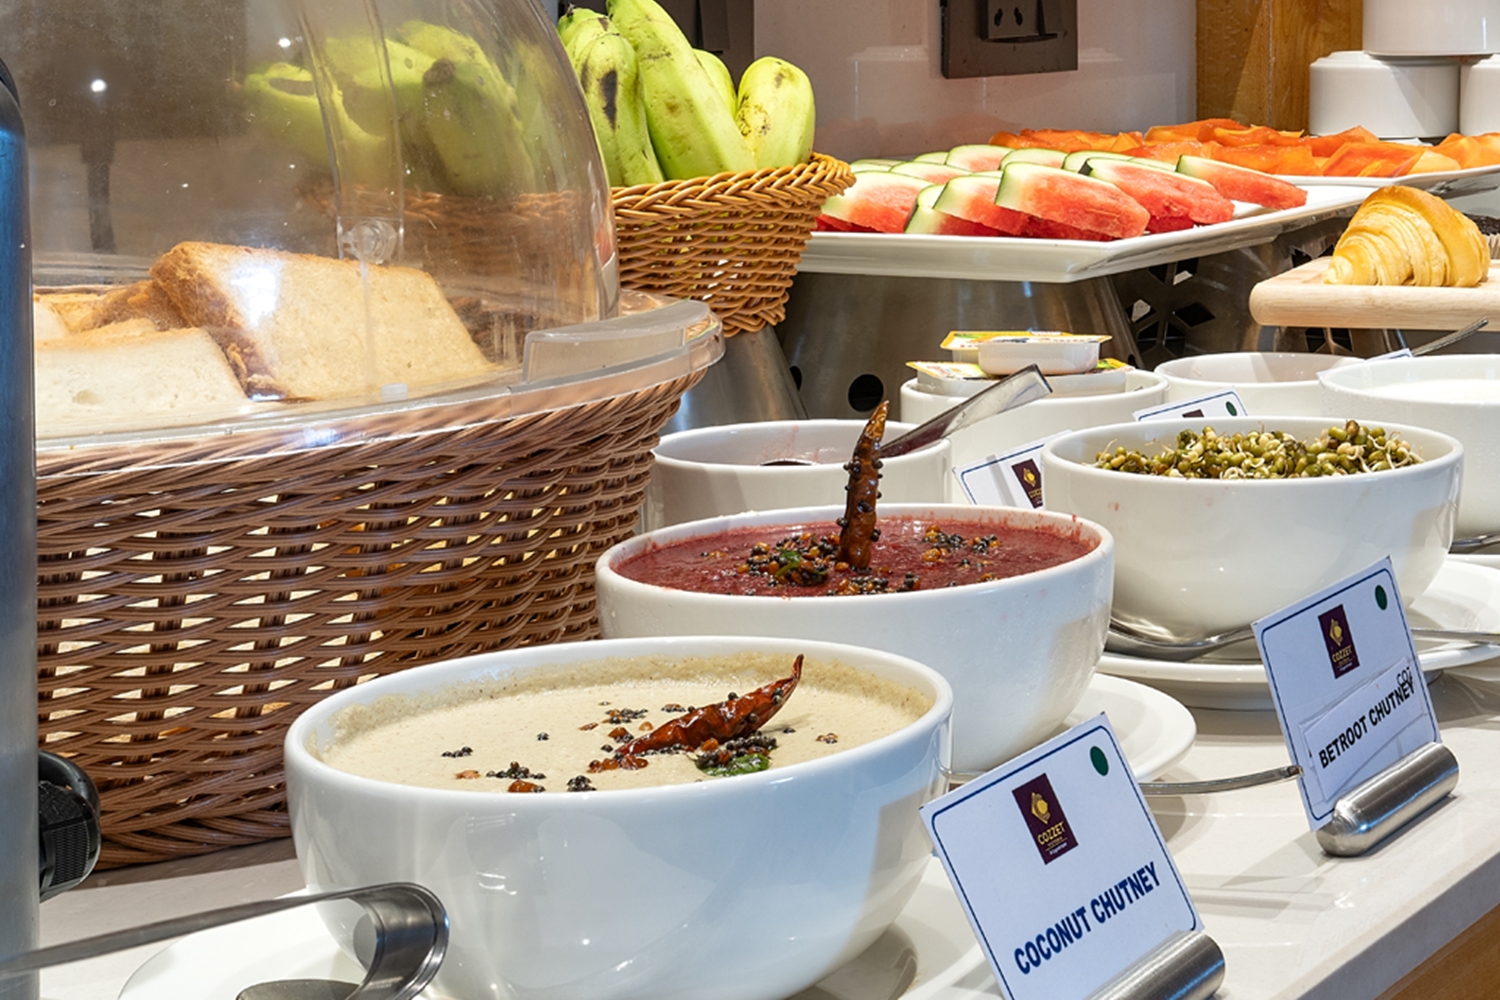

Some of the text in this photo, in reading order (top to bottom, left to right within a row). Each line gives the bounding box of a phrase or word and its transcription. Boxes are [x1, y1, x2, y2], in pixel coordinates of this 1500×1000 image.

[1318, 675, 1415, 769] BETROOT CHUTNEY
[1036, 821, 1066, 845] COZZET
[1014, 861, 1160, 975] COCONUT CHUTNEY
